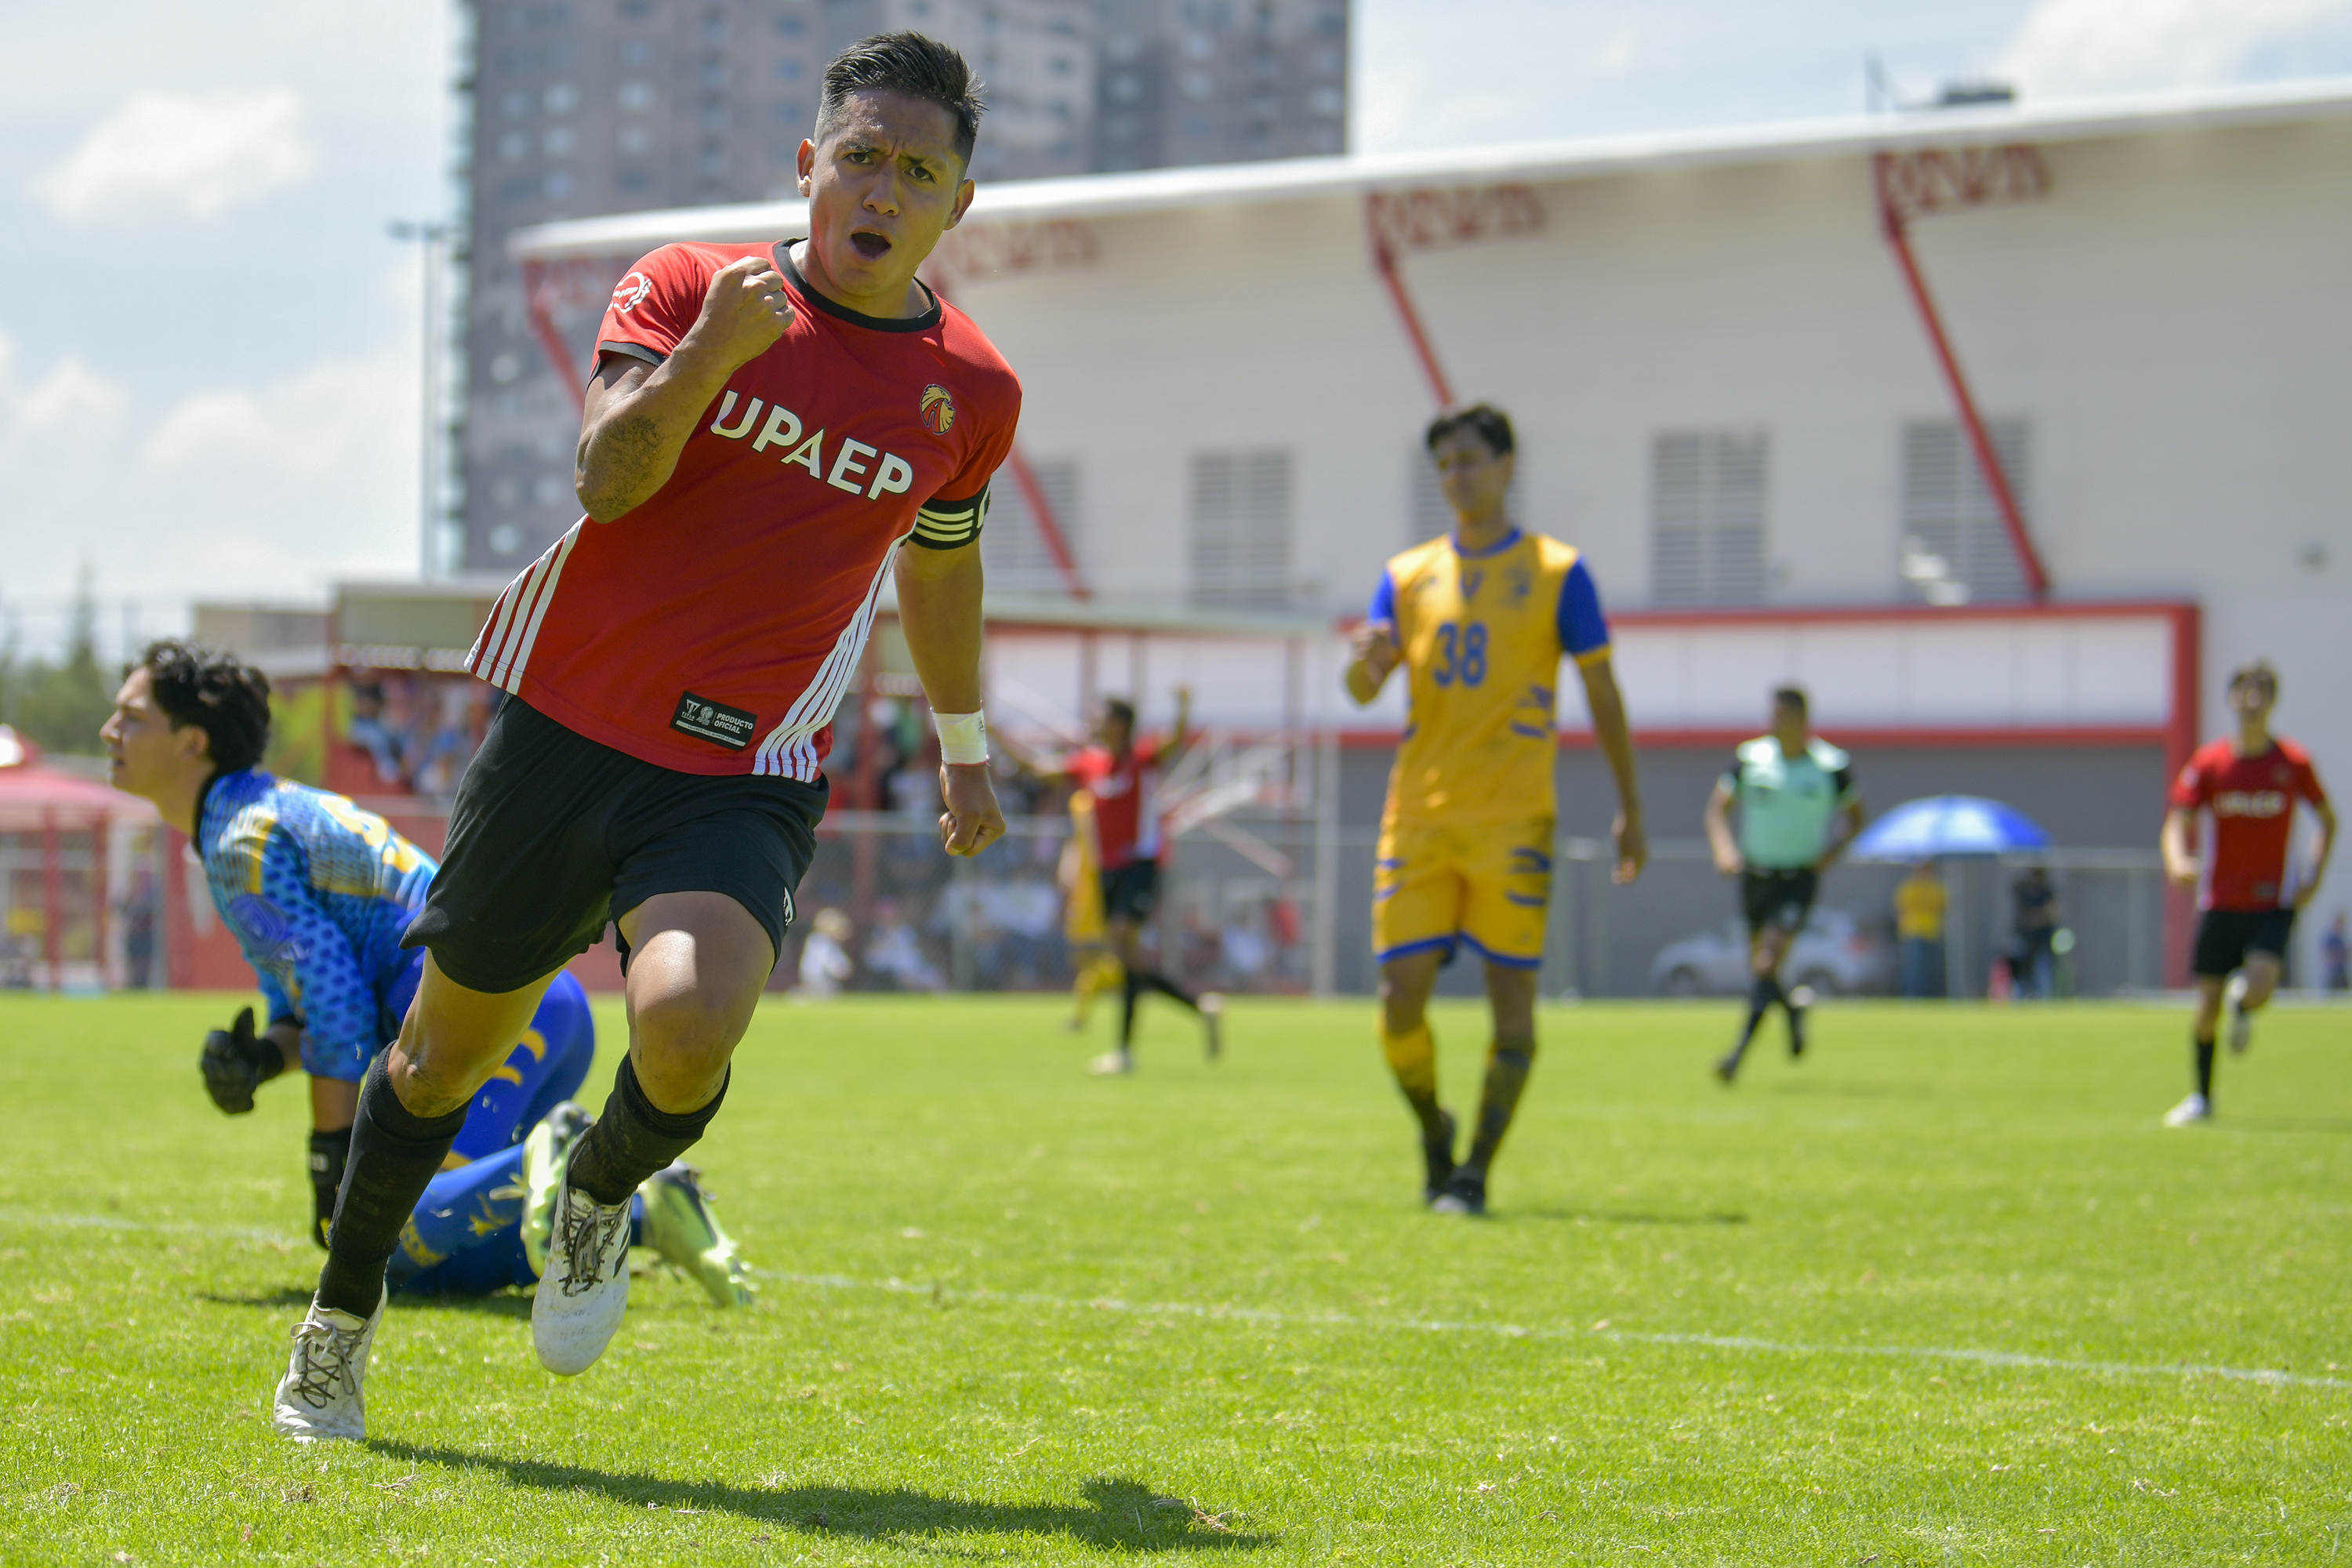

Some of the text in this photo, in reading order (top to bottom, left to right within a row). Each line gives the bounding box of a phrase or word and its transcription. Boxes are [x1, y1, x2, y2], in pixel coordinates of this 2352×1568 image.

[710, 390, 913, 501] UPAEP
[1435, 623, 1487, 687] 38
[713, 720, 741, 734] OFICIAL
[717, 713, 753, 730] PRODUCTO
